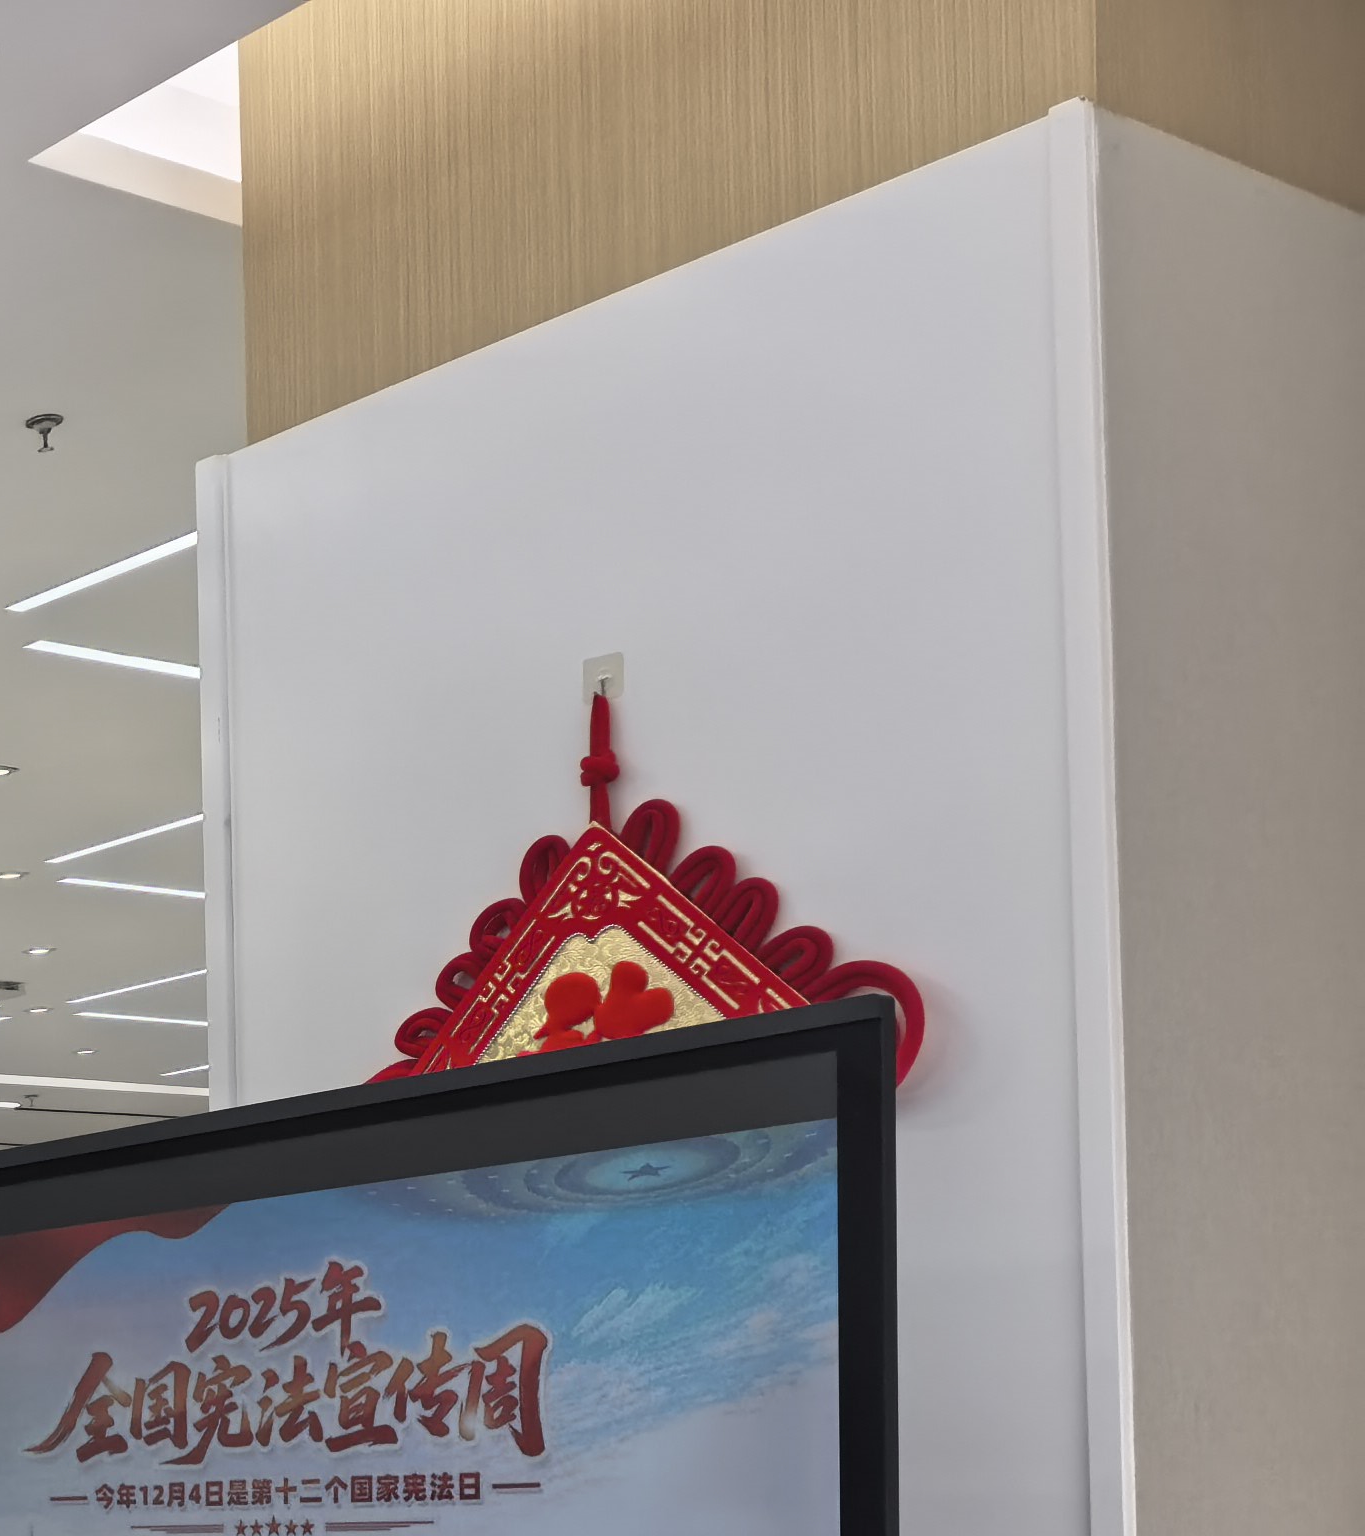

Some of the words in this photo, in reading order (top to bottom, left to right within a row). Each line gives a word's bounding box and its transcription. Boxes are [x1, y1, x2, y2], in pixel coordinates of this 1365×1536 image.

[185, 1261, 381, 1356] 2025年
[24, 1323, 547, 1466] 全国宪法宣传周
[94, 1472, 481, 1508] 今年12月4日是第十二个国家宪法日
